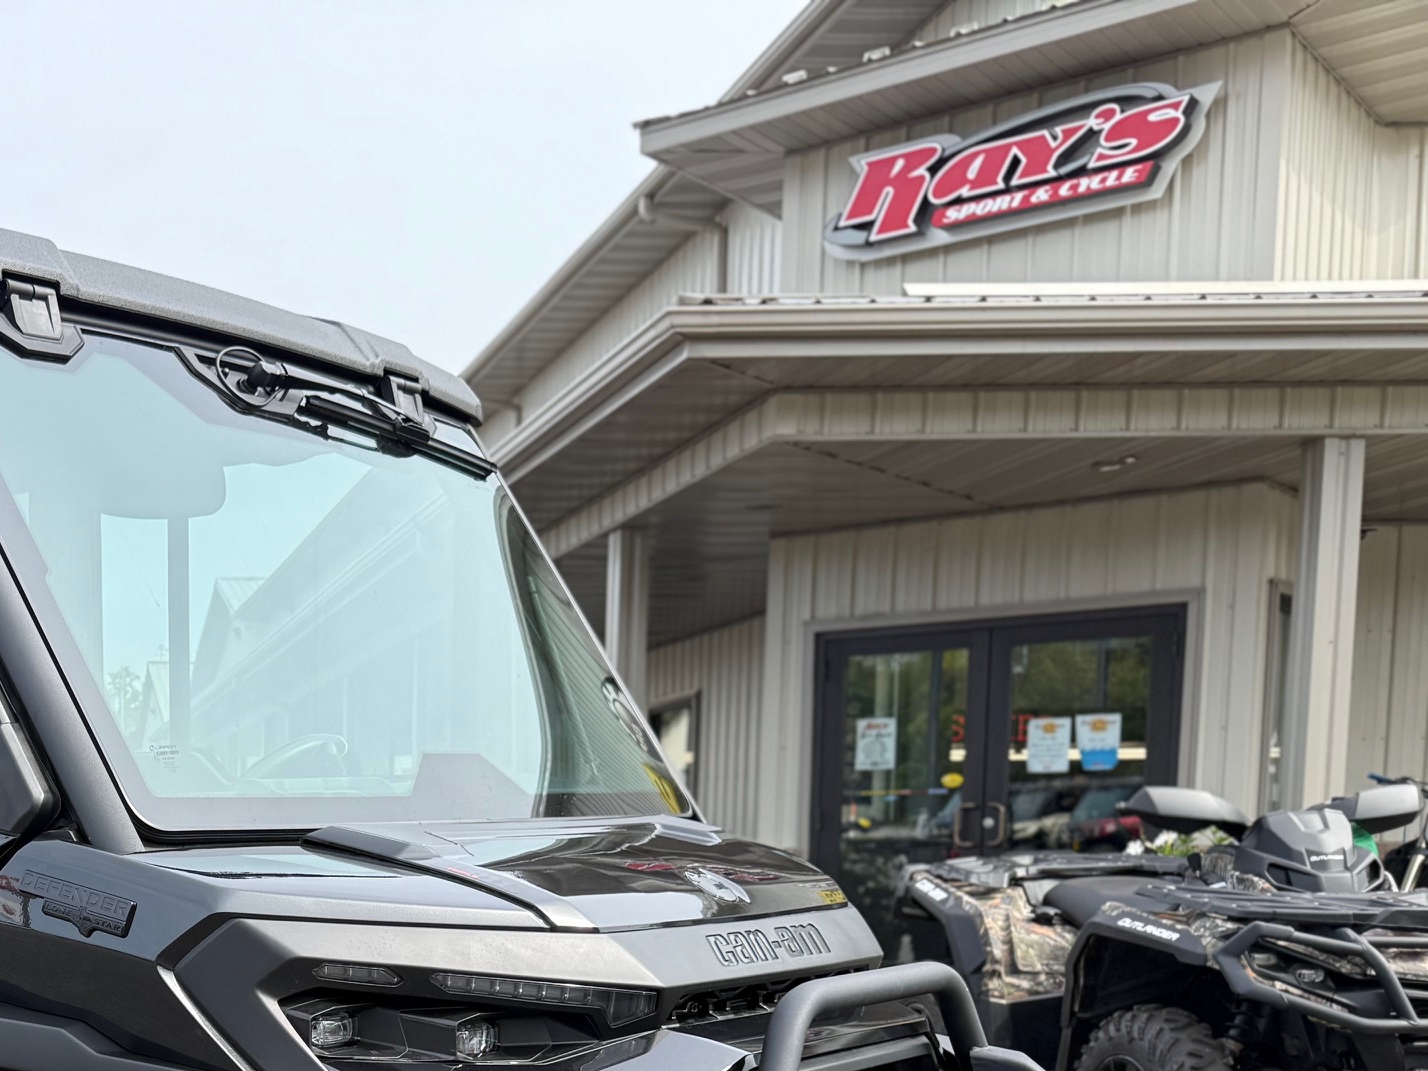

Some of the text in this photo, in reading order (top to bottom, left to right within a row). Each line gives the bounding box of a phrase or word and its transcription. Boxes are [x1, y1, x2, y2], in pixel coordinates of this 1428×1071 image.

[943, 163, 1144, 225] SPORT & CYCLE
[20, 872, 130, 917] DEFENDER
[45, 901, 123, 933] LONE STAR
[705, 922, 832, 968] can-am
[1116, 917, 1181, 942] OUTLANDER
